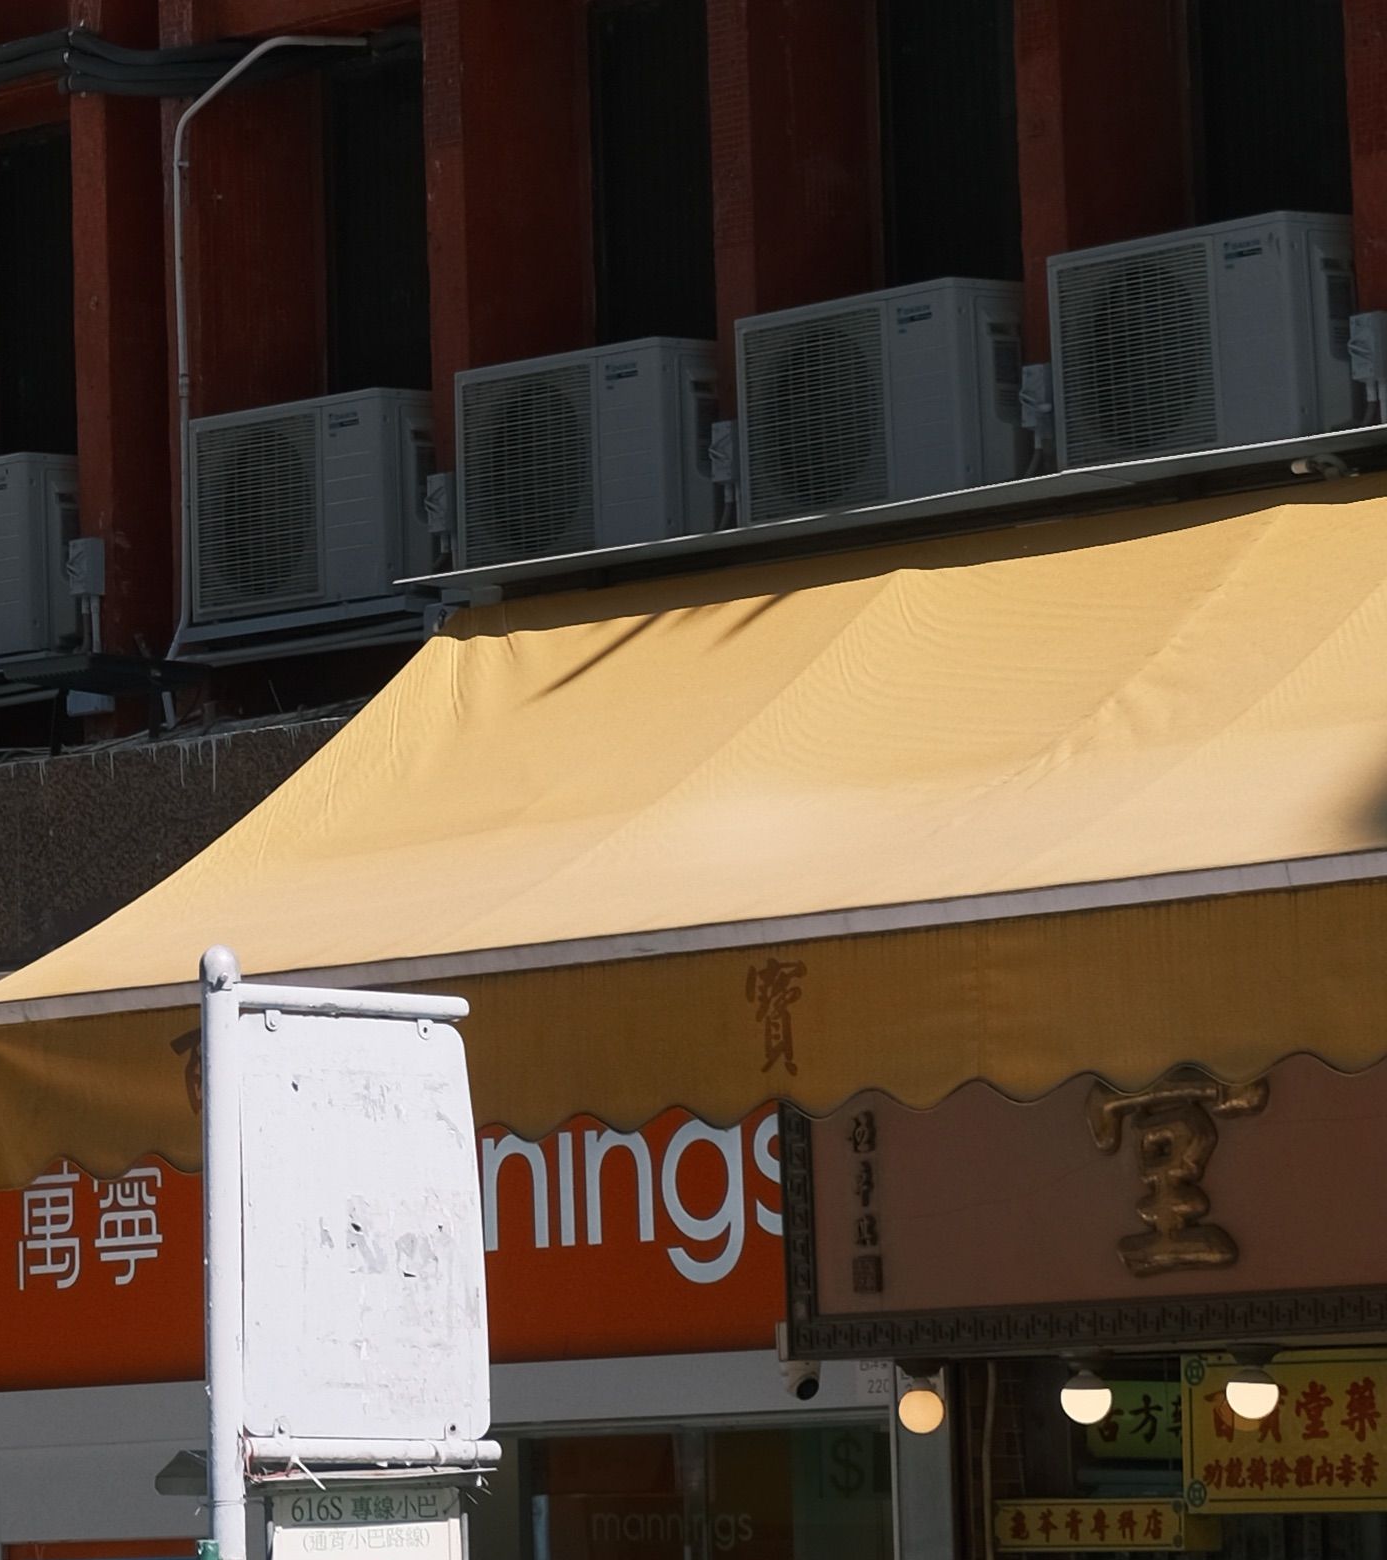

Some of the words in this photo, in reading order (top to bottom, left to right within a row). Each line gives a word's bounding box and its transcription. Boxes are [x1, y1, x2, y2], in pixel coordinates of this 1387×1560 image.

[290, 1495, 343, 1522] 616S
[350, 1495, 438, 1520] 專線小巴
